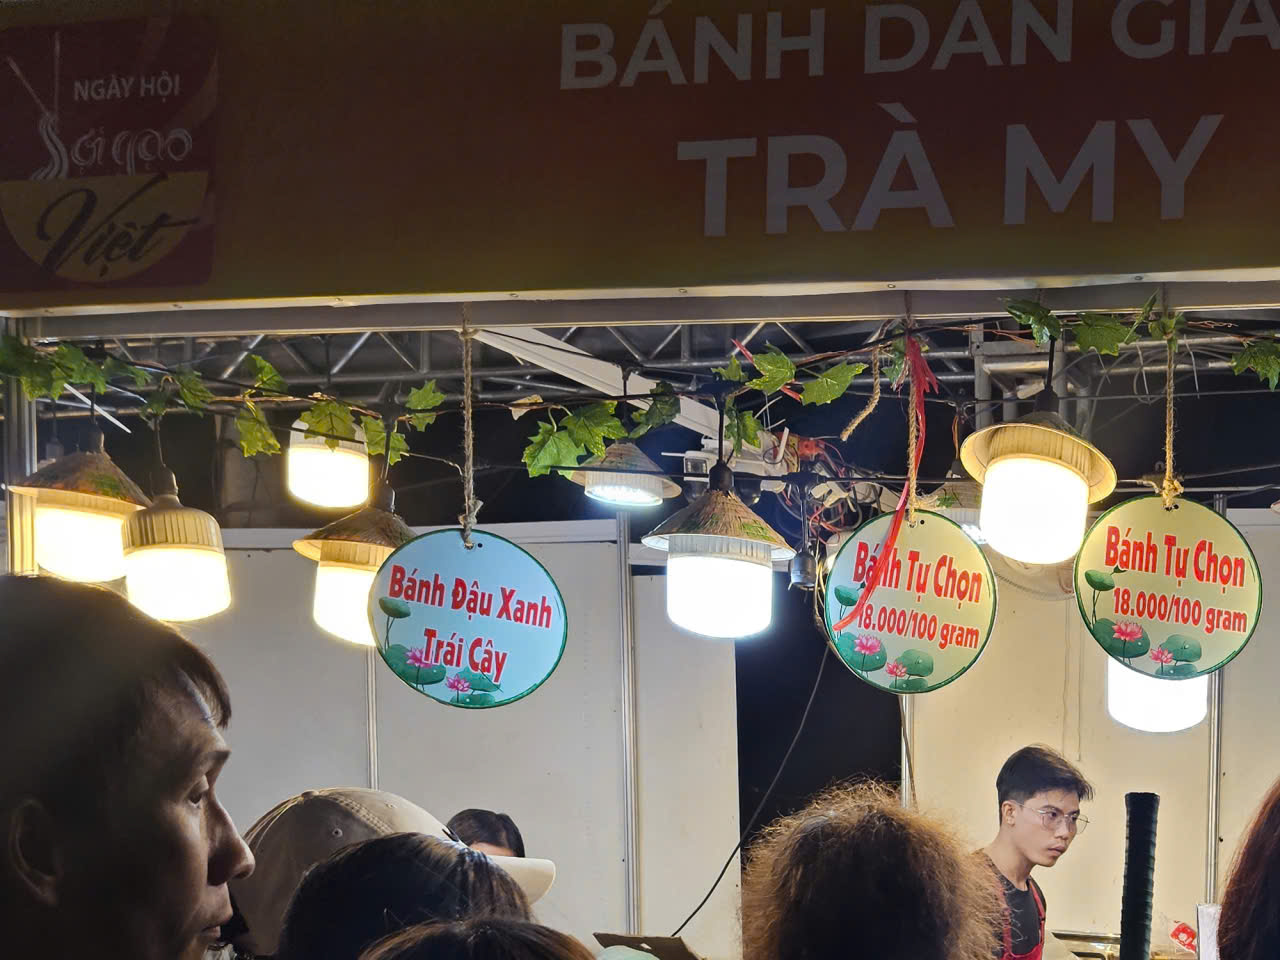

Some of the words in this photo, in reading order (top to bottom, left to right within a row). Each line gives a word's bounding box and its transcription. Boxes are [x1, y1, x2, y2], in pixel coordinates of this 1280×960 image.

[560, 0, 825, 90] BÁNH
[74, 74, 134, 101] NGÀY
[140, 70, 180, 103] HỘI
[676, 102, 956, 237] TRÀ
[1003, 113, 1225, 226] MY
[37, 171, 200, 278] Việt
[906, 550, 932, 602] Tự
[933, 554, 983, 609] Chọn
[1104, 525, 1159, 573] Bánh
[1163, 534, 1190, 587] Tự
[1193, 539, 1246, 594] Chọn
[388, 564, 446, 607] Bánh
[451, 577, 494, 620] Đậu
[496, 586, 553, 629] Xanh
[1112, 587, 1202, 627] 18.000/100
[1204, 607, 1248, 634] gram
[422, 628, 465, 668] Trái
[468, 638, 508, 683] Cây
[938, 621, 981, 650] gram
